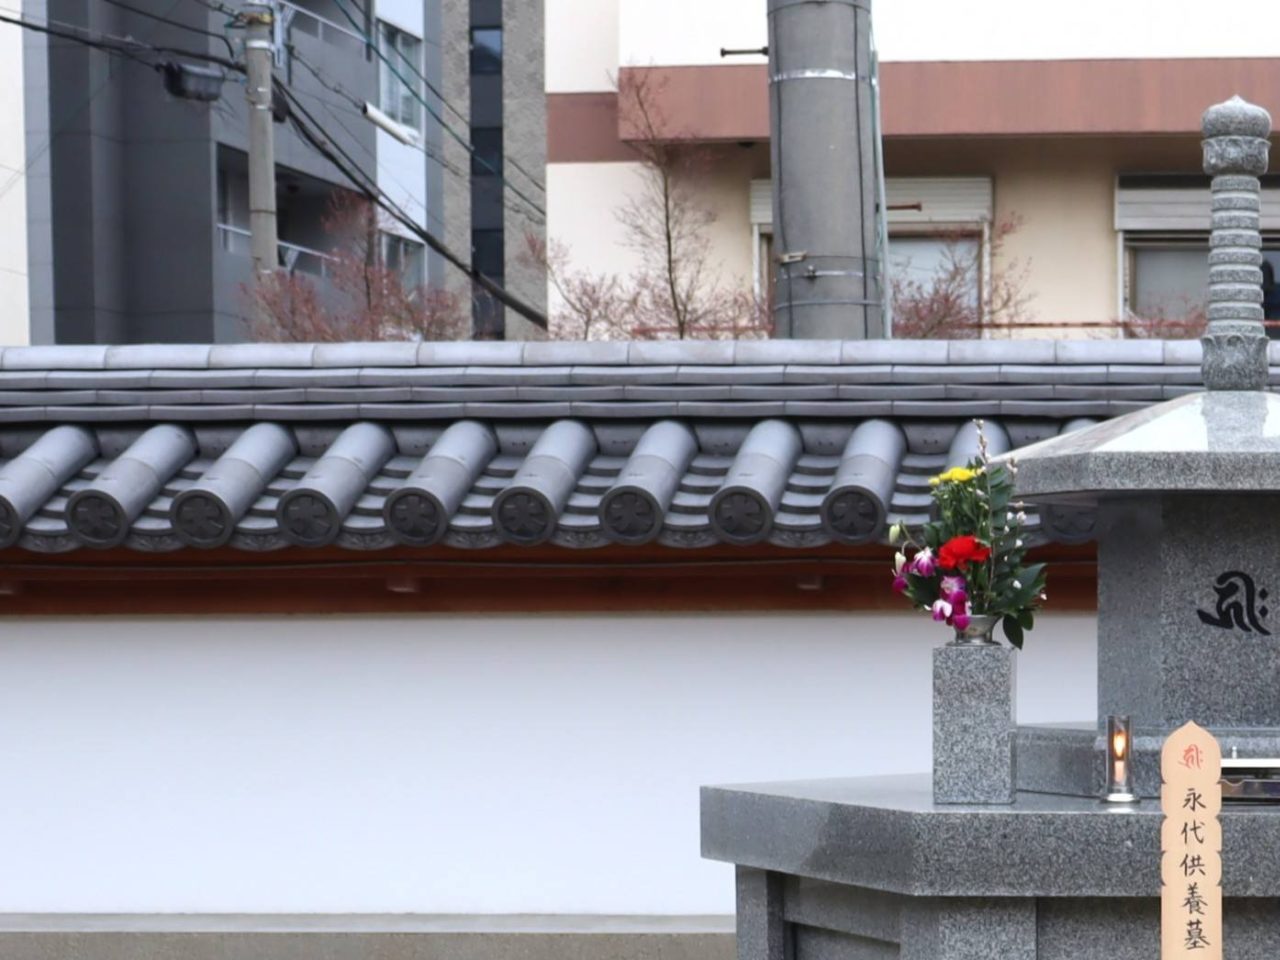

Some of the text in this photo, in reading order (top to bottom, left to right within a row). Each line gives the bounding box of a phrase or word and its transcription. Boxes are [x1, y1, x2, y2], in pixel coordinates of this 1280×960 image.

[1179, 786, 1211, 951] 永代供養墓
